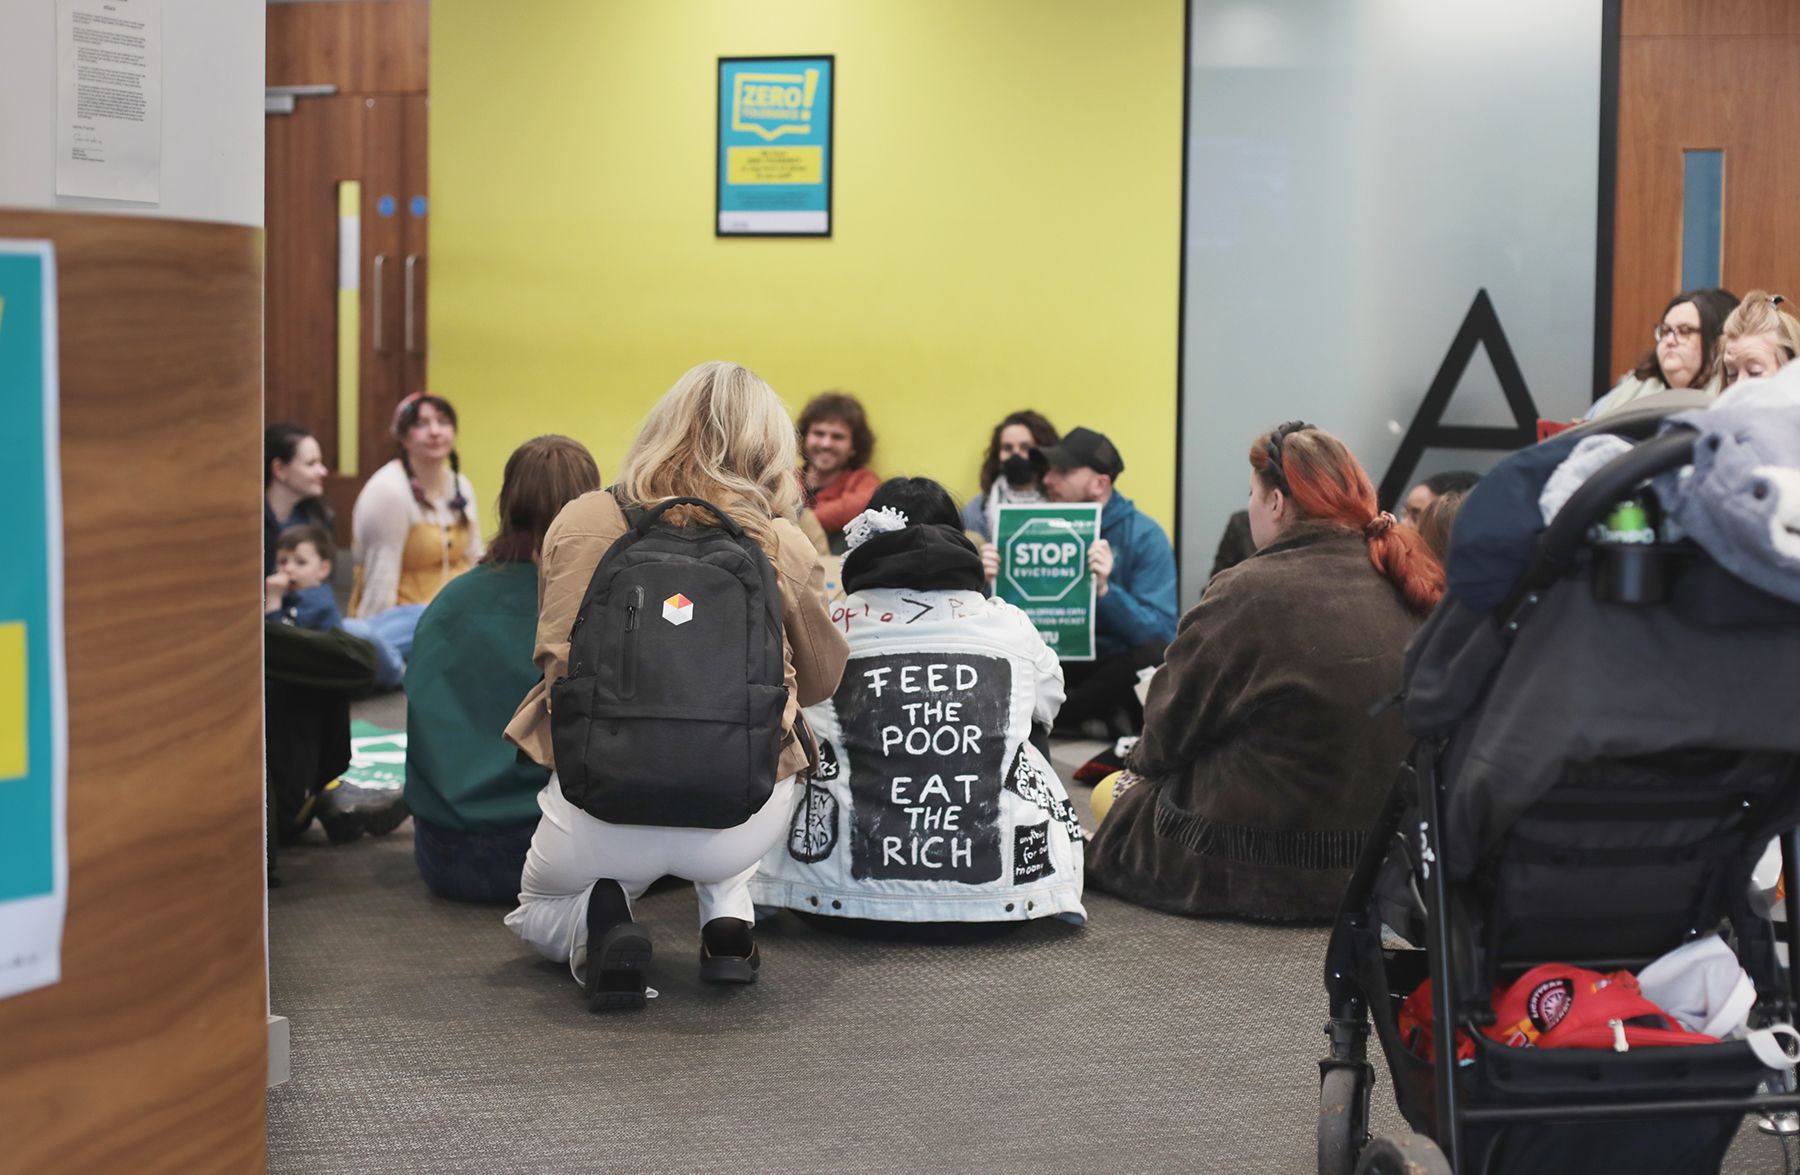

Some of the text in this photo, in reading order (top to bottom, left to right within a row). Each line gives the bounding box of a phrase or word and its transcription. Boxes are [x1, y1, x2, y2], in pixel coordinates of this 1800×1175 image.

[1015, 542, 1078, 565] STOP
[1013, 567, 1076, 578] EVICTIONS
[863, 663, 978, 697] FEED
[902, 700, 964, 726] THE
[881, 725, 983, 757] POOR
[891, 773, 979, 804] EAT
[903, 805, 962, 831] THE
[883, 836, 972, 868] RICH
